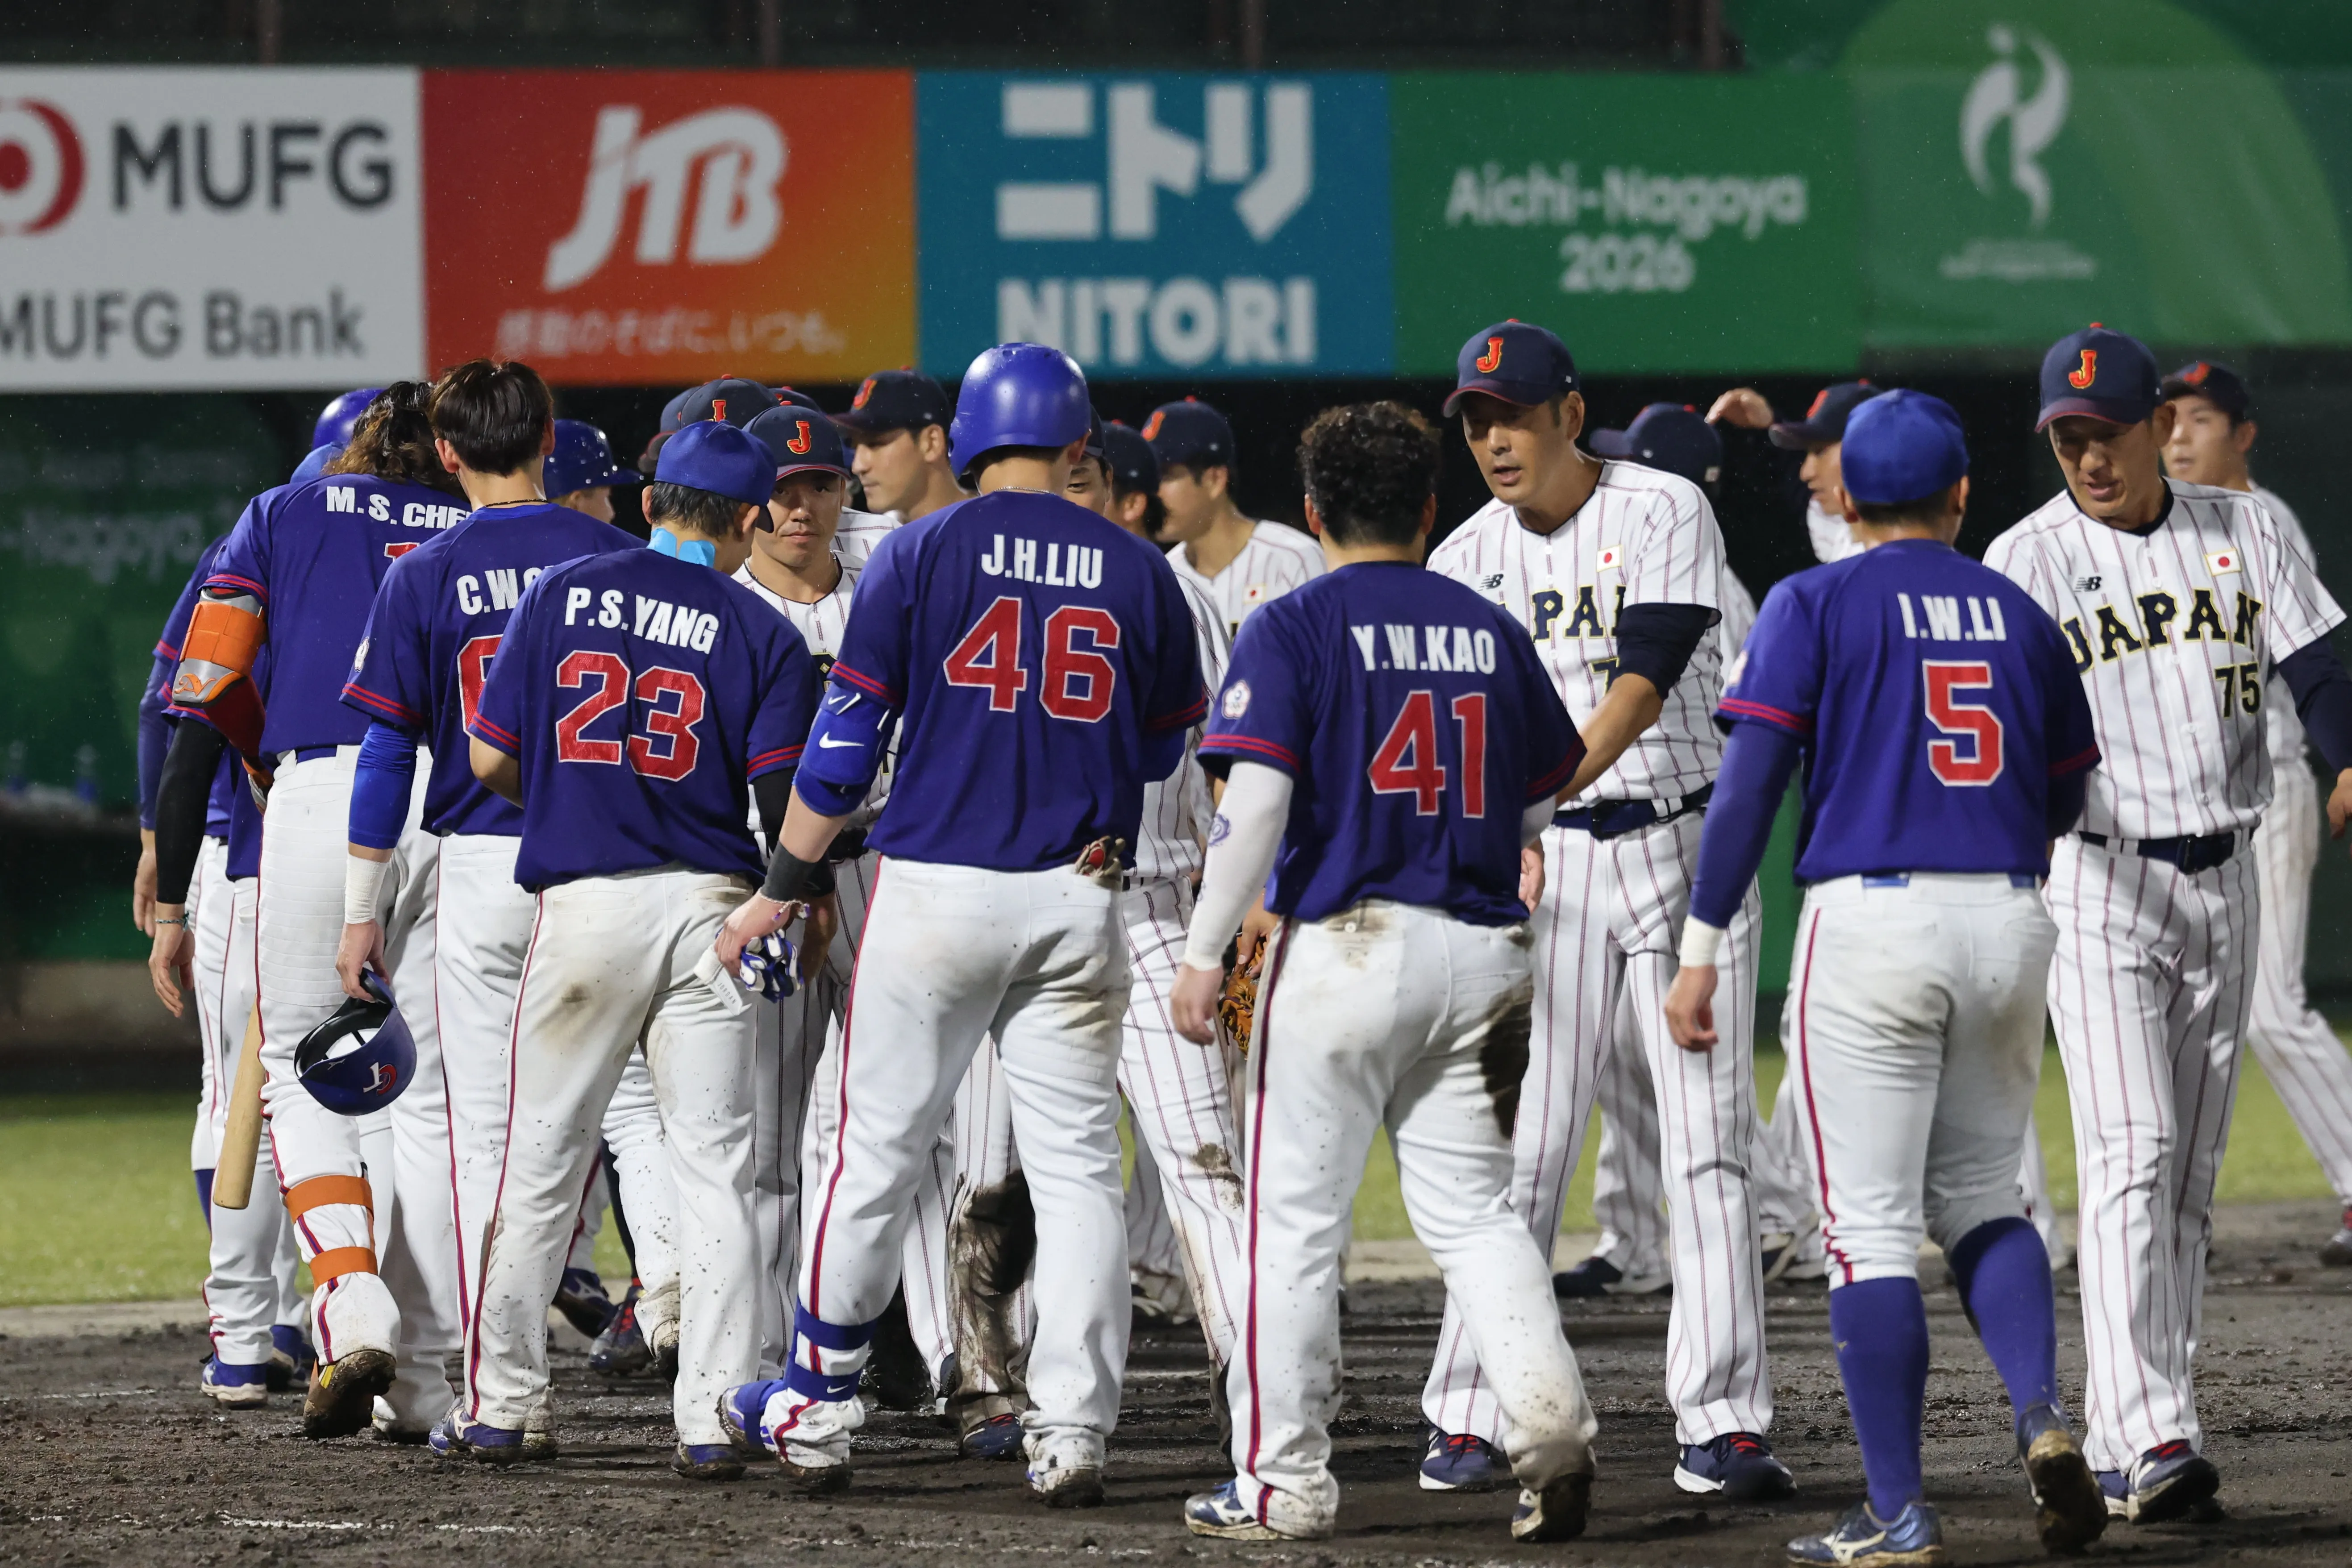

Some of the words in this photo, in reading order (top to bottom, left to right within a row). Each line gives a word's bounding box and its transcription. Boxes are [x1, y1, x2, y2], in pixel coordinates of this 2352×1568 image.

[111, 119, 394, 212] MUFG
[995, 82, 1312, 241] ニトリ
[542, 104, 787, 292] JTB
[1445, 161, 1807, 241] Aichi-Nagoya
[1559, 232, 1694, 292] 2026
[0, 290, 180, 360] MUFG
[205, 284, 364, 357] Bank
[997, 276, 1316, 367] NITORI
[1476, 337, 1503, 373] J
[2068, 350, 2097, 389] J
[787, 421, 812, 454] J
[326, 486, 472, 529] M.S.CHE
[982, 534, 1103, 589] J.H.LIU
[565, 587, 719, 654] P.S.YANG
[1350, 624, 1495, 674] Y.W.KAO
[1897, 593, 2006, 641] I.W.LI
[2061, 588, 2264, 676] JAPAN
[943, 596, 1120, 723] 46
[2215, 661, 2261, 718] 75
[556, 650, 705, 782] 23
[1922, 659, 2004, 787] 5
[1367, 690, 1486, 818] 41
[718, 982, 737, 1004] JORDAN
